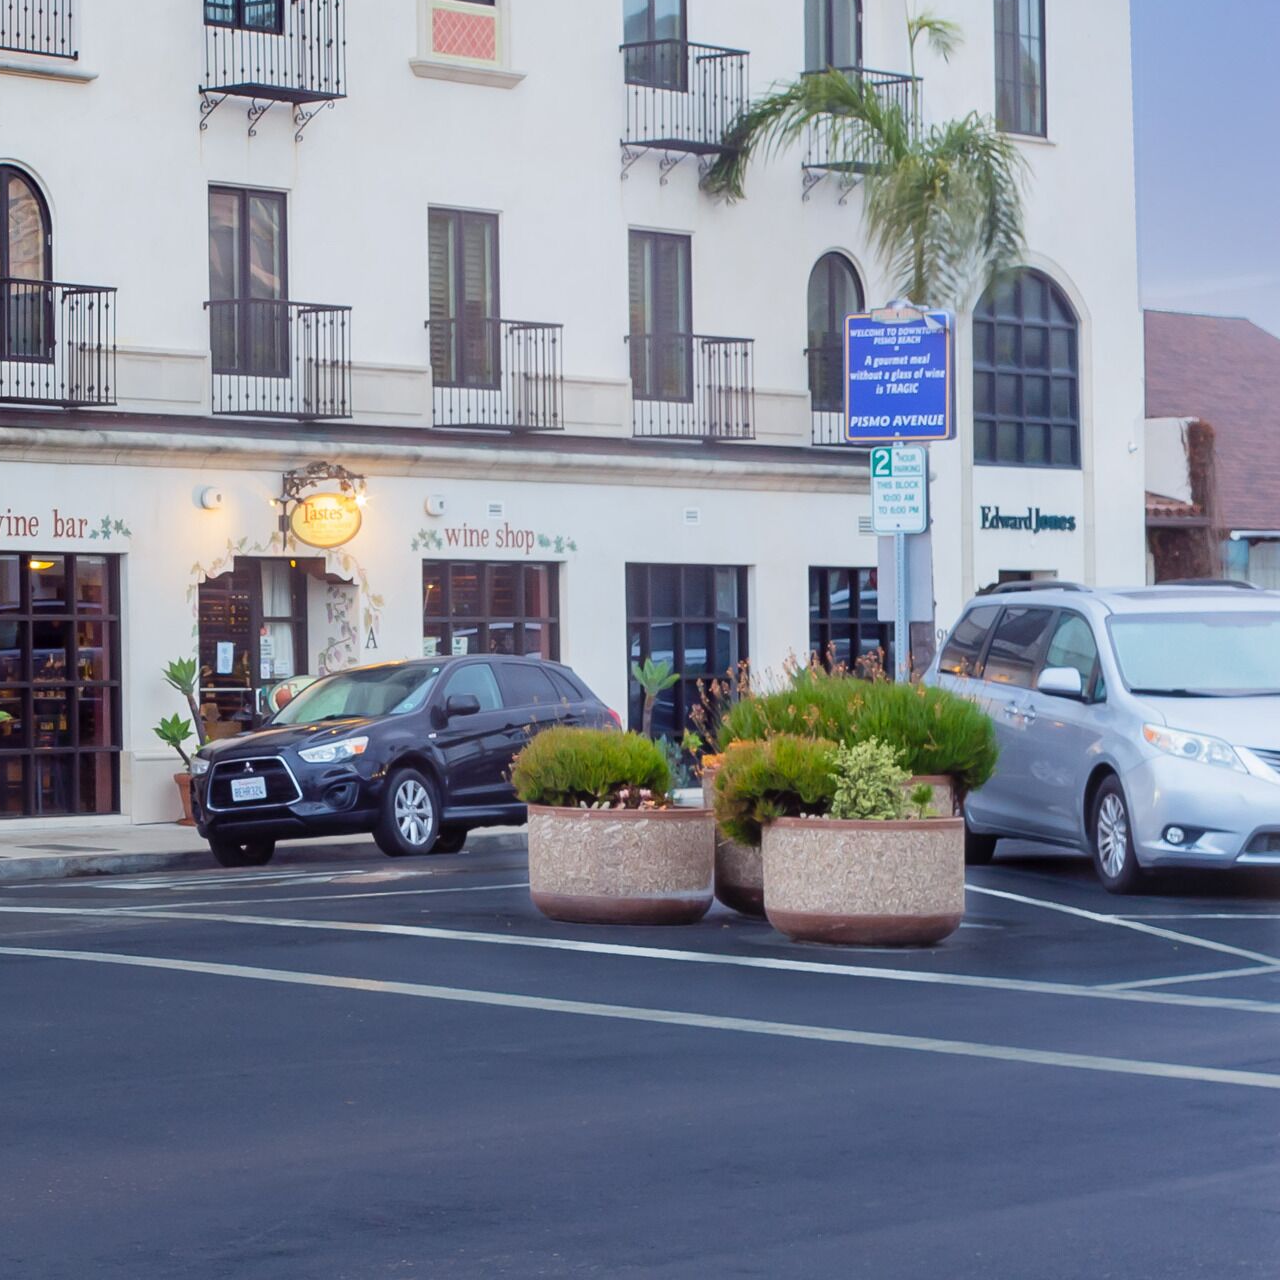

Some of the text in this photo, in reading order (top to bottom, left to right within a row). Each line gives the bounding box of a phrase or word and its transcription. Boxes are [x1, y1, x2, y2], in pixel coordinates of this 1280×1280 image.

[850, 328, 884, 337] WELCOME
[886, 327, 897, 336] TO
[873, 336, 921, 345] PISMO BEACH
[864, 353, 931, 368] A gourmet meal
[850, 368, 945, 382] without a glass of wine
[876, 382, 920, 395] is TRAGIC
[850, 413, 944, 427] PISMO AVENUE
[875, 450, 890, 475] 2
[877, 481, 919, 489] THIS BLOCK
[303, 502, 343, 524] Tastes
[878, 506, 888, 514] TO
[52, 509, 88, 538] bar
[980, 506, 1076, 534] Edward Jones
[444, 522, 535, 554] wine shop
[365, 626, 378, 648] A
